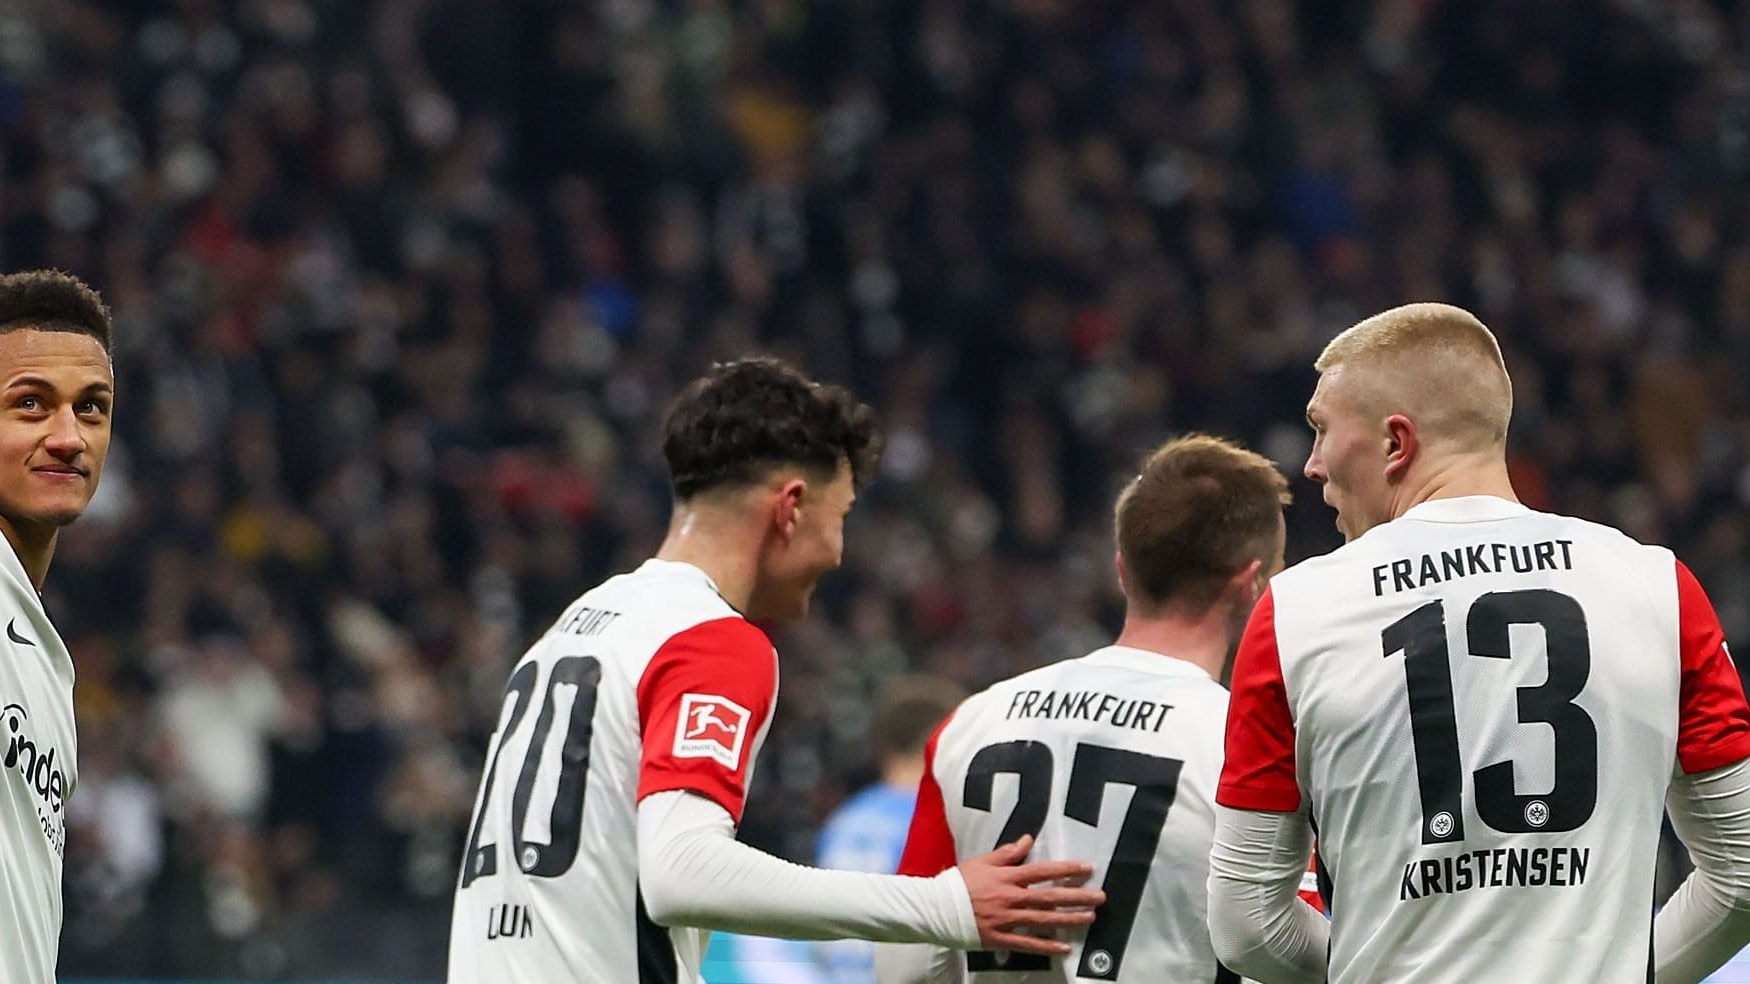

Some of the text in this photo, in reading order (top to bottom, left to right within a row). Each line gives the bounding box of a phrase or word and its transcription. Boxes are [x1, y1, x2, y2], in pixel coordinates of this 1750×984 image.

[1372, 540, 1574, 596] FRANKFURT
[461, 655, 602, 889] 20
[1006, 690, 1174, 732] FRANKFURT
[1381, 588, 1598, 845] 13
[963, 740, 1185, 981] 27
[1400, 848, 1590, 900] KRISTENSEN
